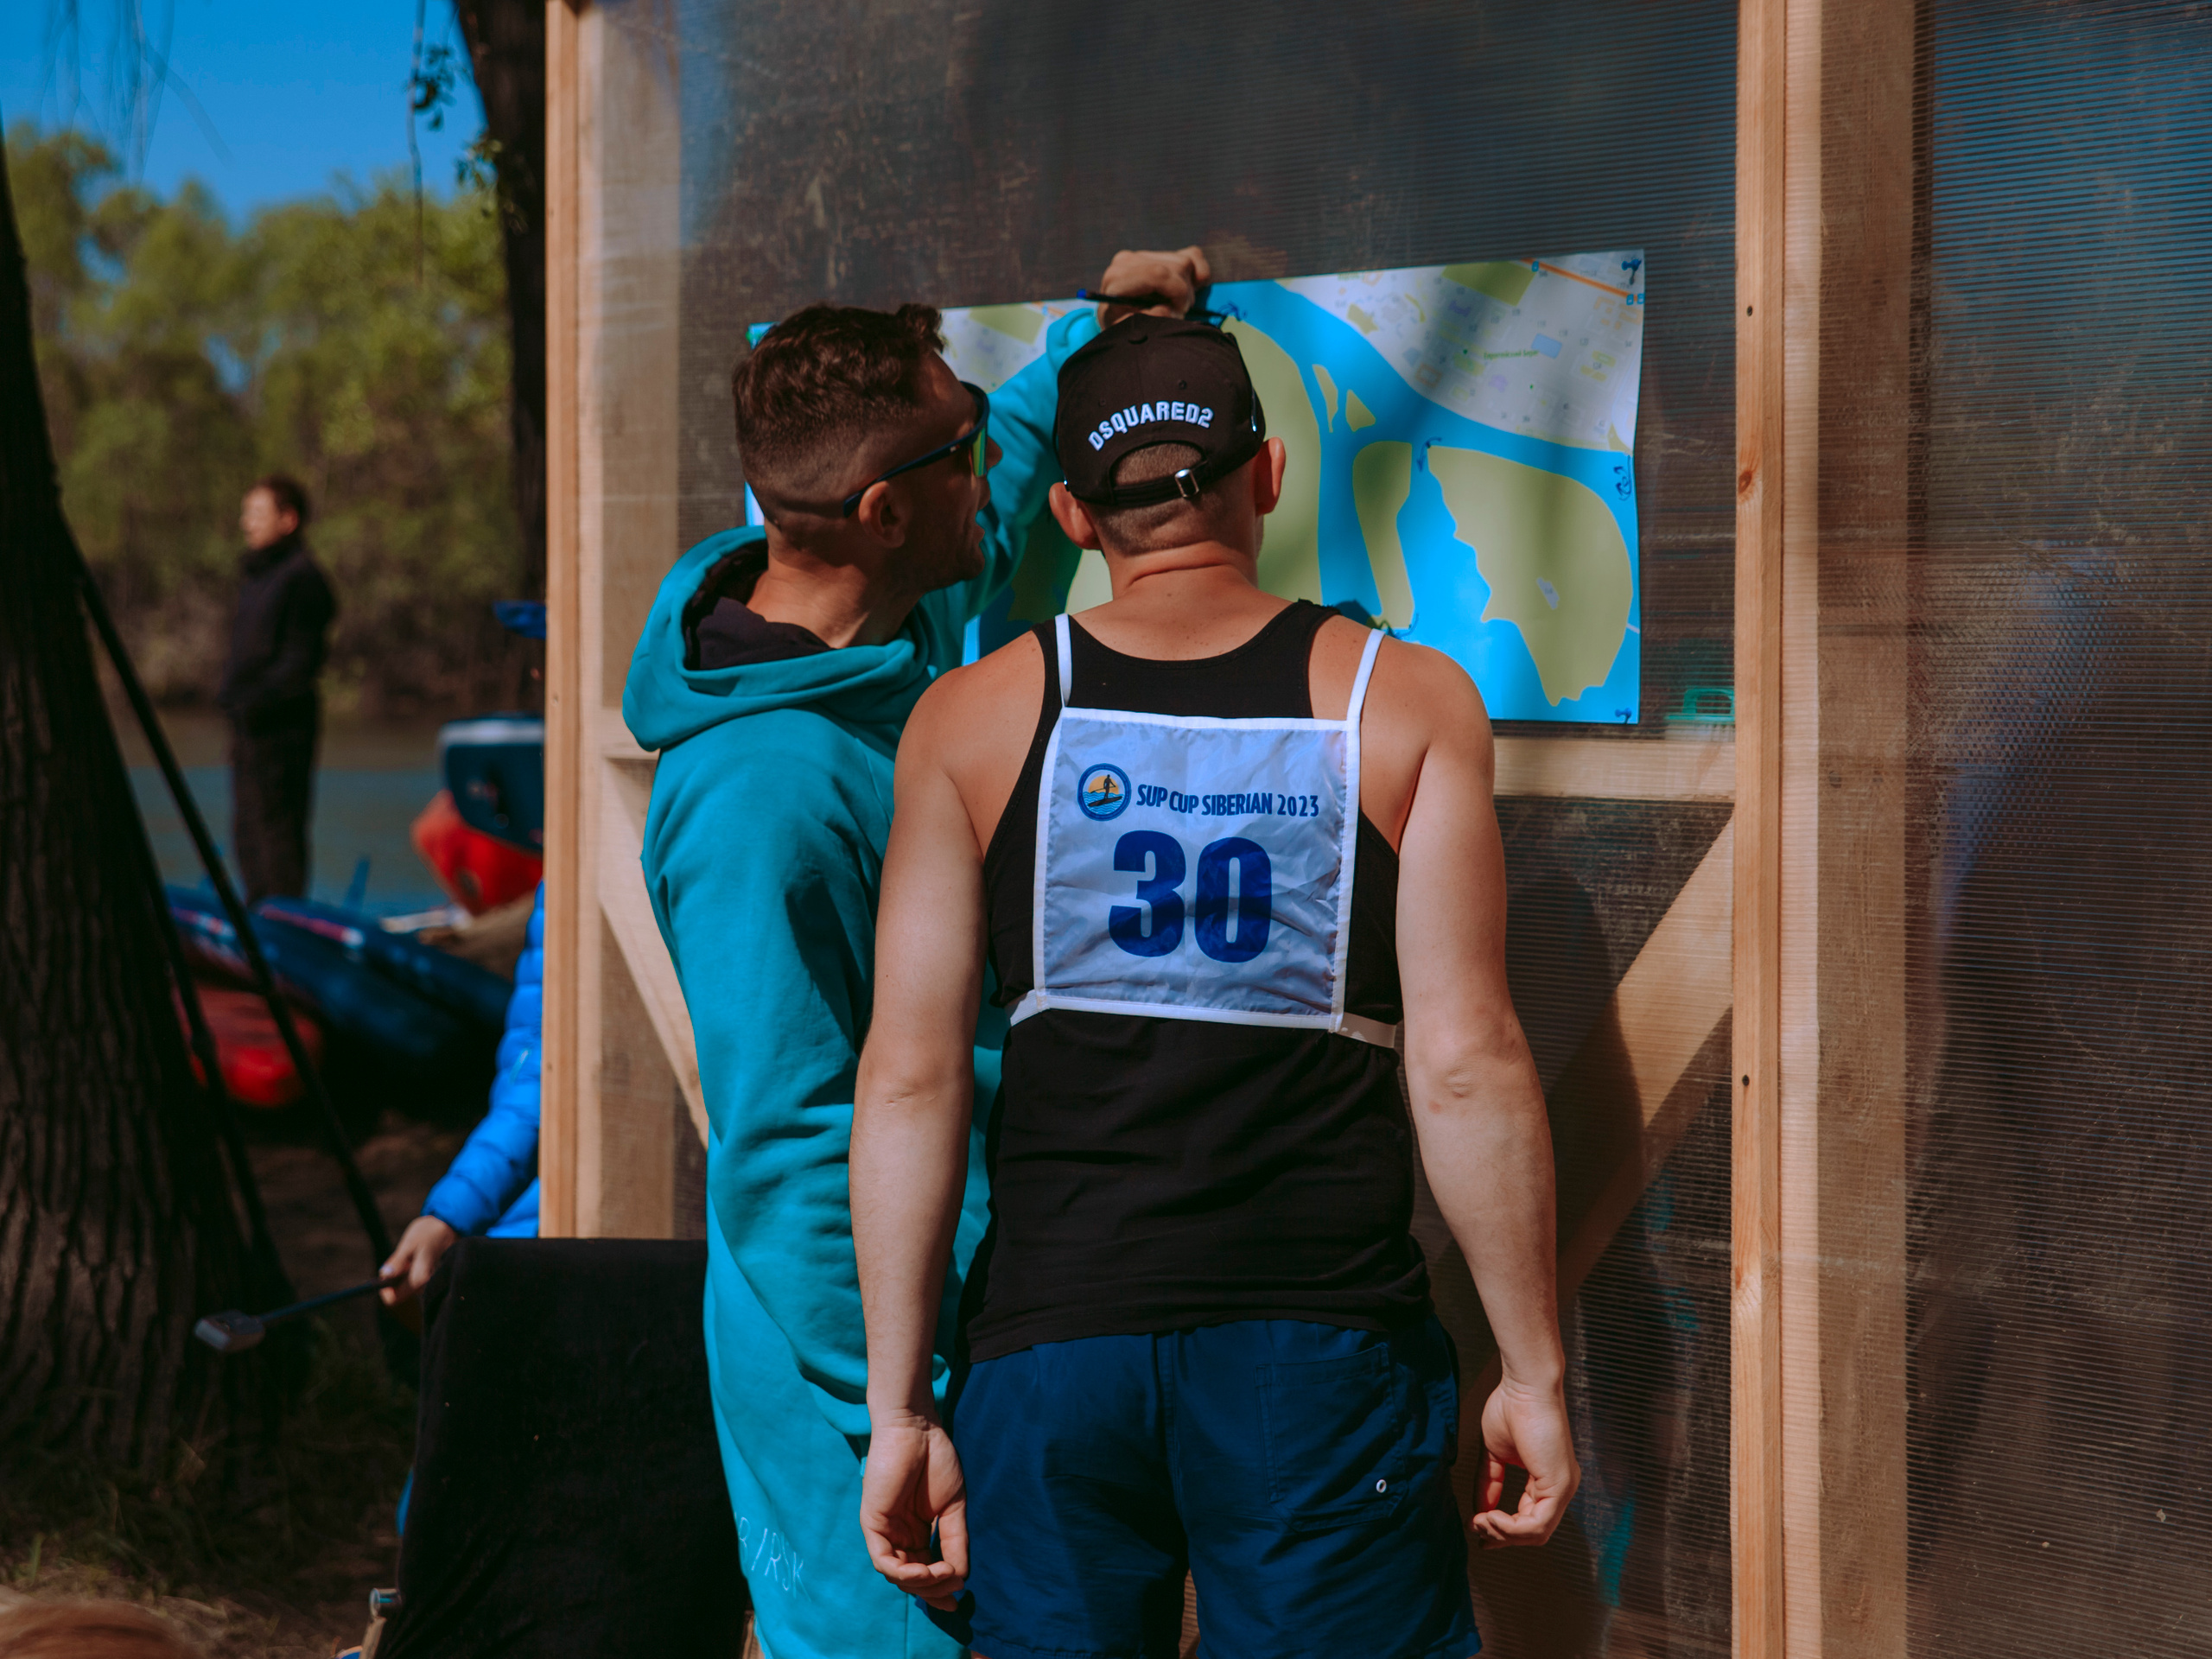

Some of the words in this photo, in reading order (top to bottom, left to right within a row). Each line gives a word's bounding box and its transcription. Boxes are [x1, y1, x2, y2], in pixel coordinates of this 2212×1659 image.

[1088, 401, 1214, 451] DSQUARED2
[1136, 784, 1168, 808] SUP
[1169, 791, 1198, 814] CUP
[1201, 792, 1273, 816] SIBERIAN
[1277, 795, 1319, 817] 2023
[1108, 830, 1272, 963] 30
